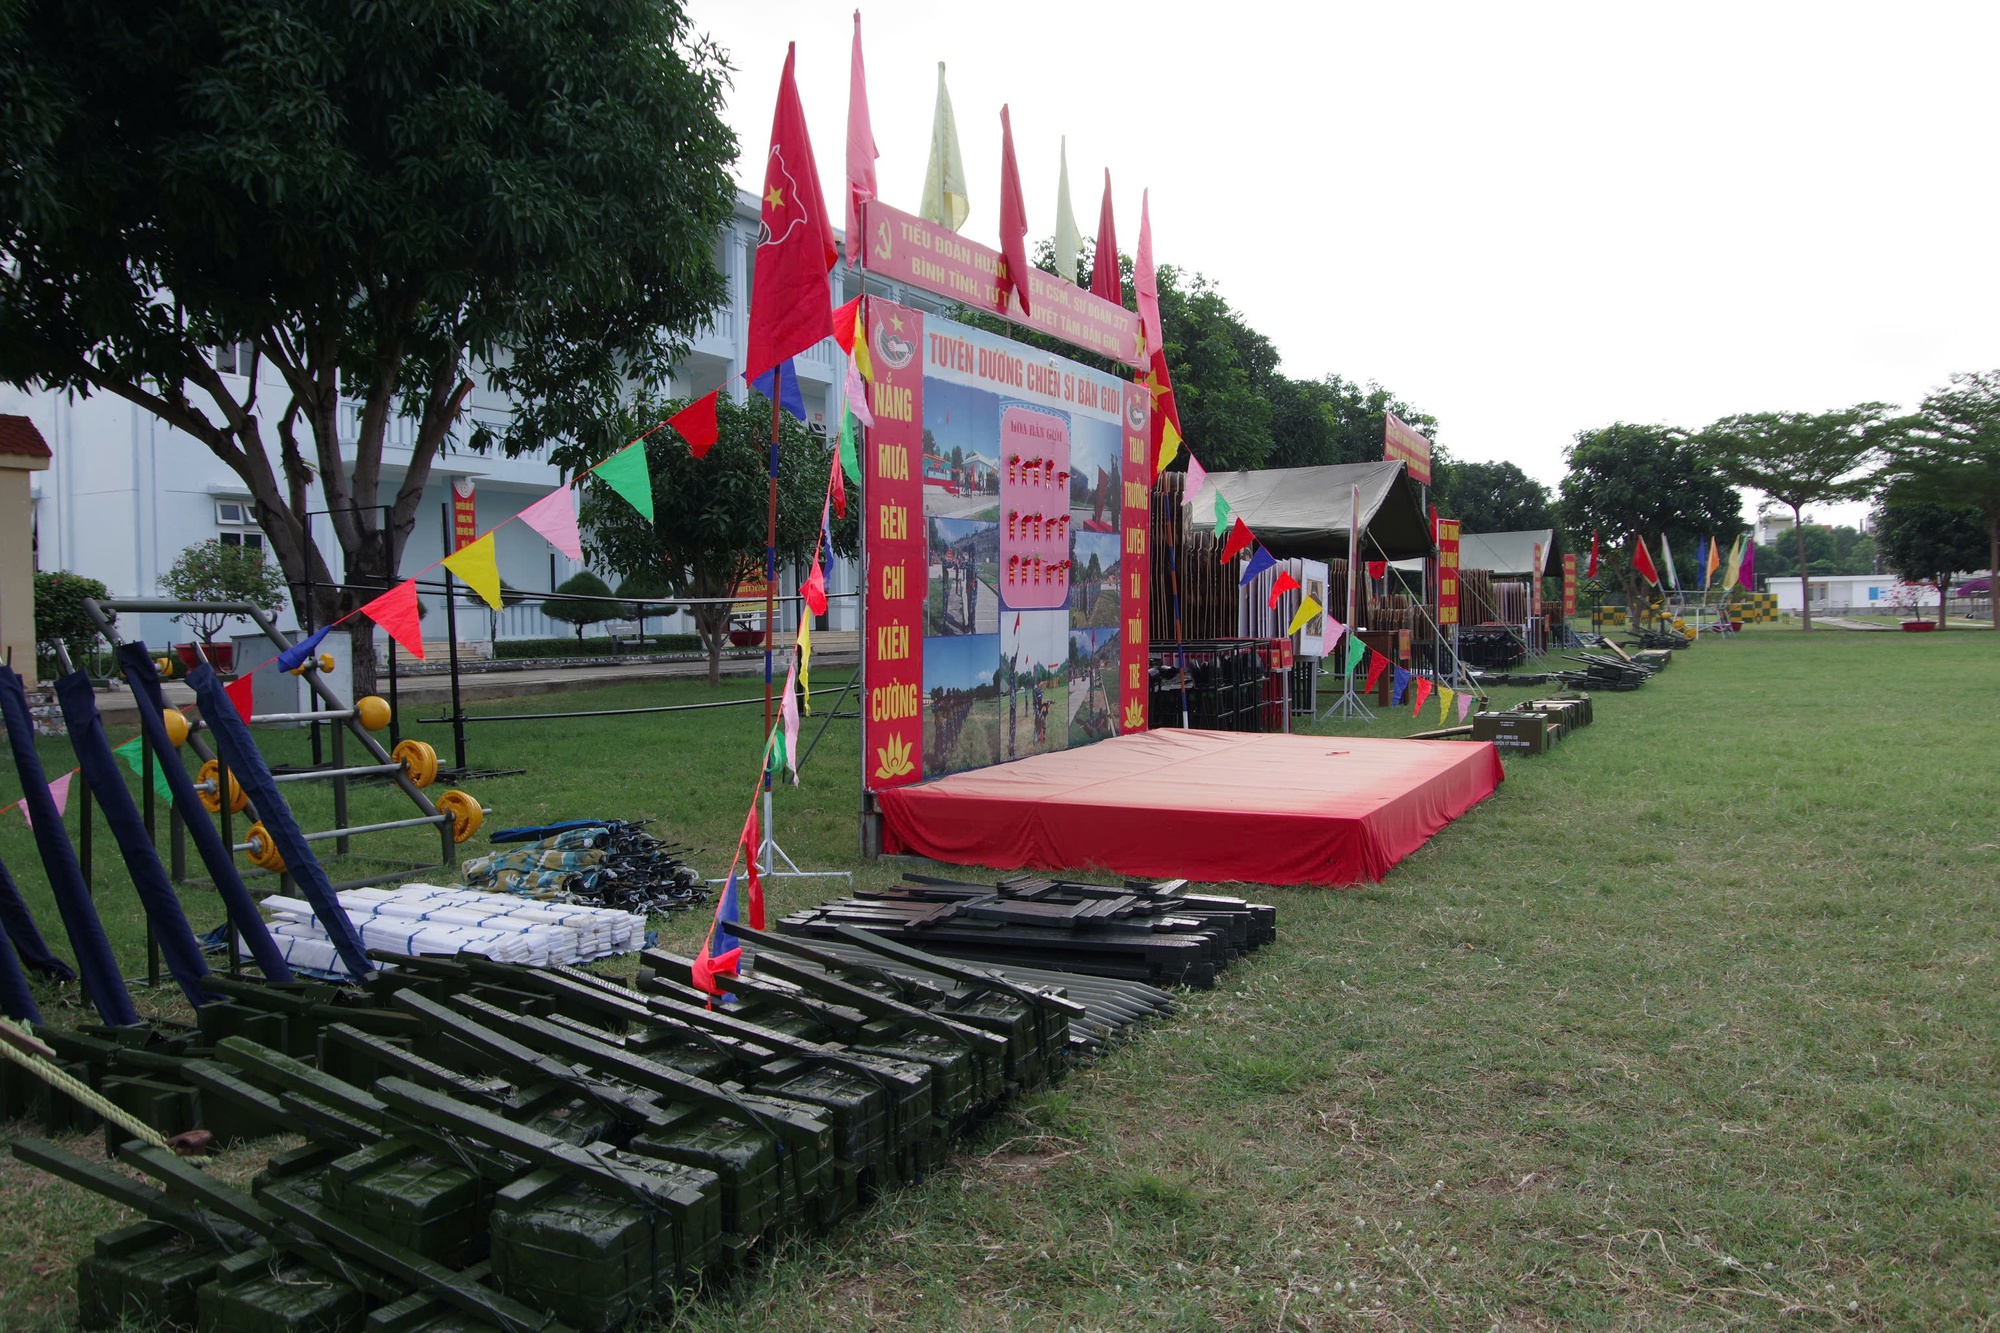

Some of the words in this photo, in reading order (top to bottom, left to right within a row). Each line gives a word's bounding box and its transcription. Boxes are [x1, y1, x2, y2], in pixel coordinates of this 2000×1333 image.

[901, 221, 931, 249] TIỂU
[935, 236, 971, 265] ĐOÀN
[975, 252, 1007, 279] HUẤN
[1074, 296, 1087, 314] SƯ
[1113, 314, 1128, 332] 377
[912, 256, 945, 284] BÌNH
[984, 284, 1000, 307] TỰ
[1030, 304, 1058, 328] UYẾT
[1061, 315, 1080, 337] TÂM
[1083, 322, 1101, 345] BẮN
[929, 332, 974, 374] TUYÊN
[978, 347, 1023, 388] DƯƠNG
[1064, 371, 1075, 402] SĨ
[1078, 373, 1098, 409] BẮN
[874, 371, 912, 423] NẮNG
[878, 443, 909, 481] MƯA
[1129, 436, 1144, 465] THAO
[1124, 477, 1148, 510] TRƯỜNG
[880, 498, 907, 540] RÈN
[1126, 523, 1145, 560] LUYỆN
[882, 559, 905, 600] CHÍ
[1131, 567, 1140, 599] TÀI
[878, 619, 909, 661] KIÊN
[1128, 608, 1142, 645] TUỔI
[1129, 654, 1140, 689] TRẺ
[872, 677, 918, 722] CƯỜNG
